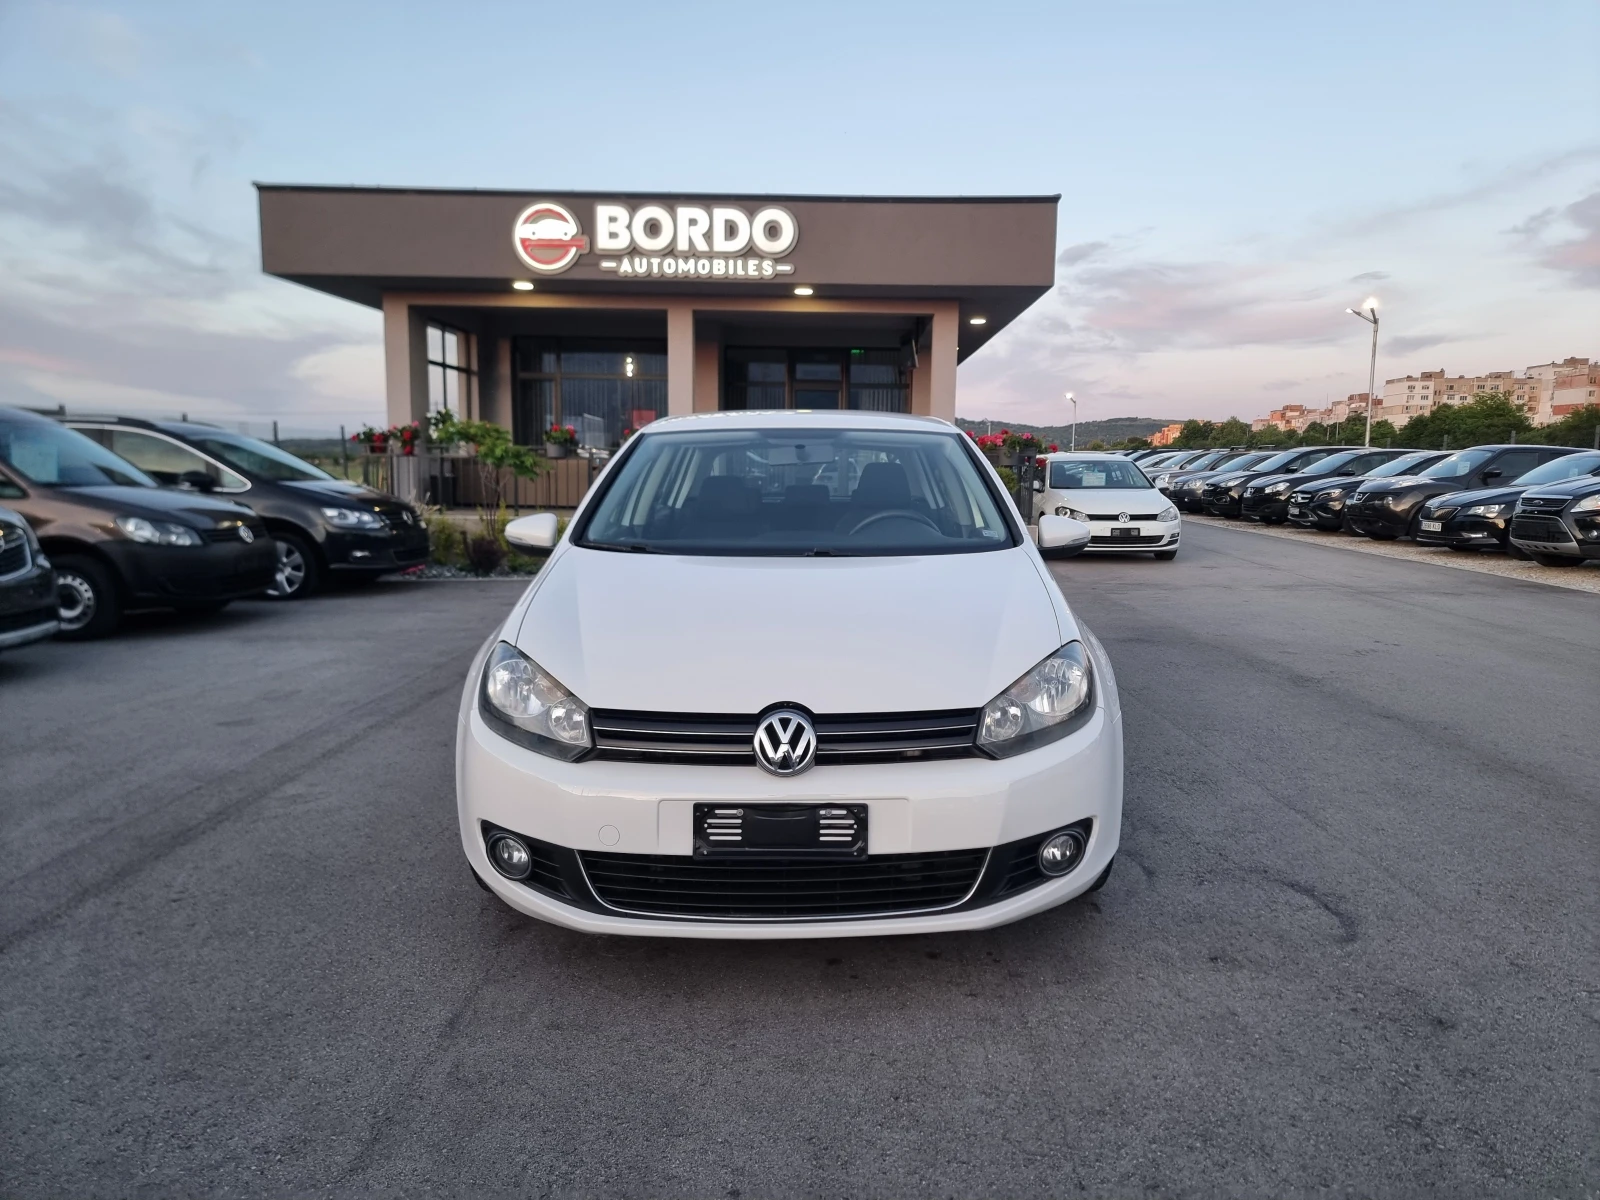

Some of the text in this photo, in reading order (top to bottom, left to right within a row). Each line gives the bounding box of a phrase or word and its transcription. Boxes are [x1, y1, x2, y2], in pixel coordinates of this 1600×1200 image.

[597, 205, 795, 254] BORDO
[619, 257, 774, 276] AUTOMOBILES
[756, 711, 814, 773] VW
